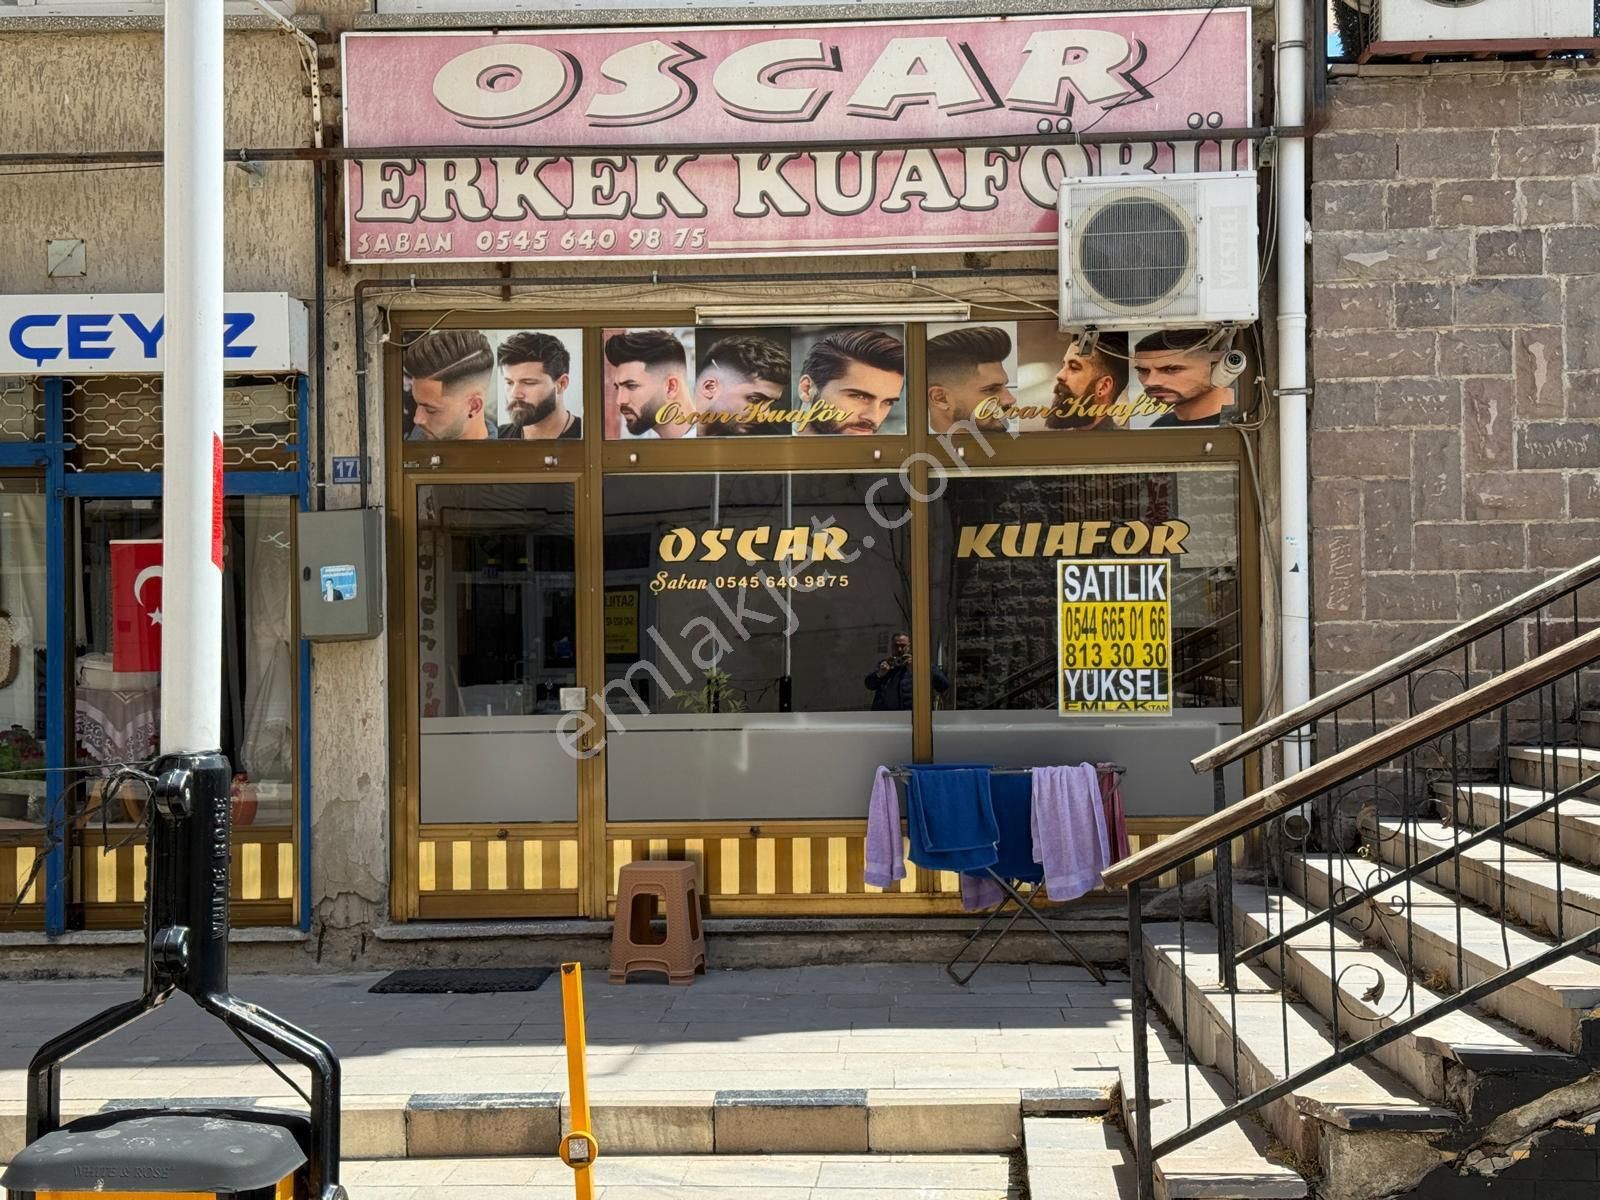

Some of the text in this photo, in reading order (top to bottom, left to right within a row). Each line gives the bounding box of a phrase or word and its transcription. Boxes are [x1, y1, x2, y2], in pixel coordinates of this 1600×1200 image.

[432, 28, 1154, 128] OSCAR
[355, 154, 707, 223] ERKEK
[476, 229, 549, 252] 0545
[560, 228, 616, 251] 640
[628, 227, 662, 250] 98
[673, 226, 707, 249] 75
[9, 313, 257, 367] ÇEYZ
[655, 399, 855, 432] Oscar Kuaför
[974, 393, 1176, 428] Oscar Kuaför
[658, 526, 849, 562] OSCAR
[956, 519, 1191, 558] KUAFOR
[650, 571, 849, 595] Şaban 0545 640 9875
[1064, 565, 1166, 601] SATILIK
[1065, 606, 1166, 641] 0544 665 01 66
[1065, 643, 1167, 667] 813 30 30
[1064, 669, 1168, 701] YÜKSEL
[212, 797, 227, 940] WHITE ROSE
